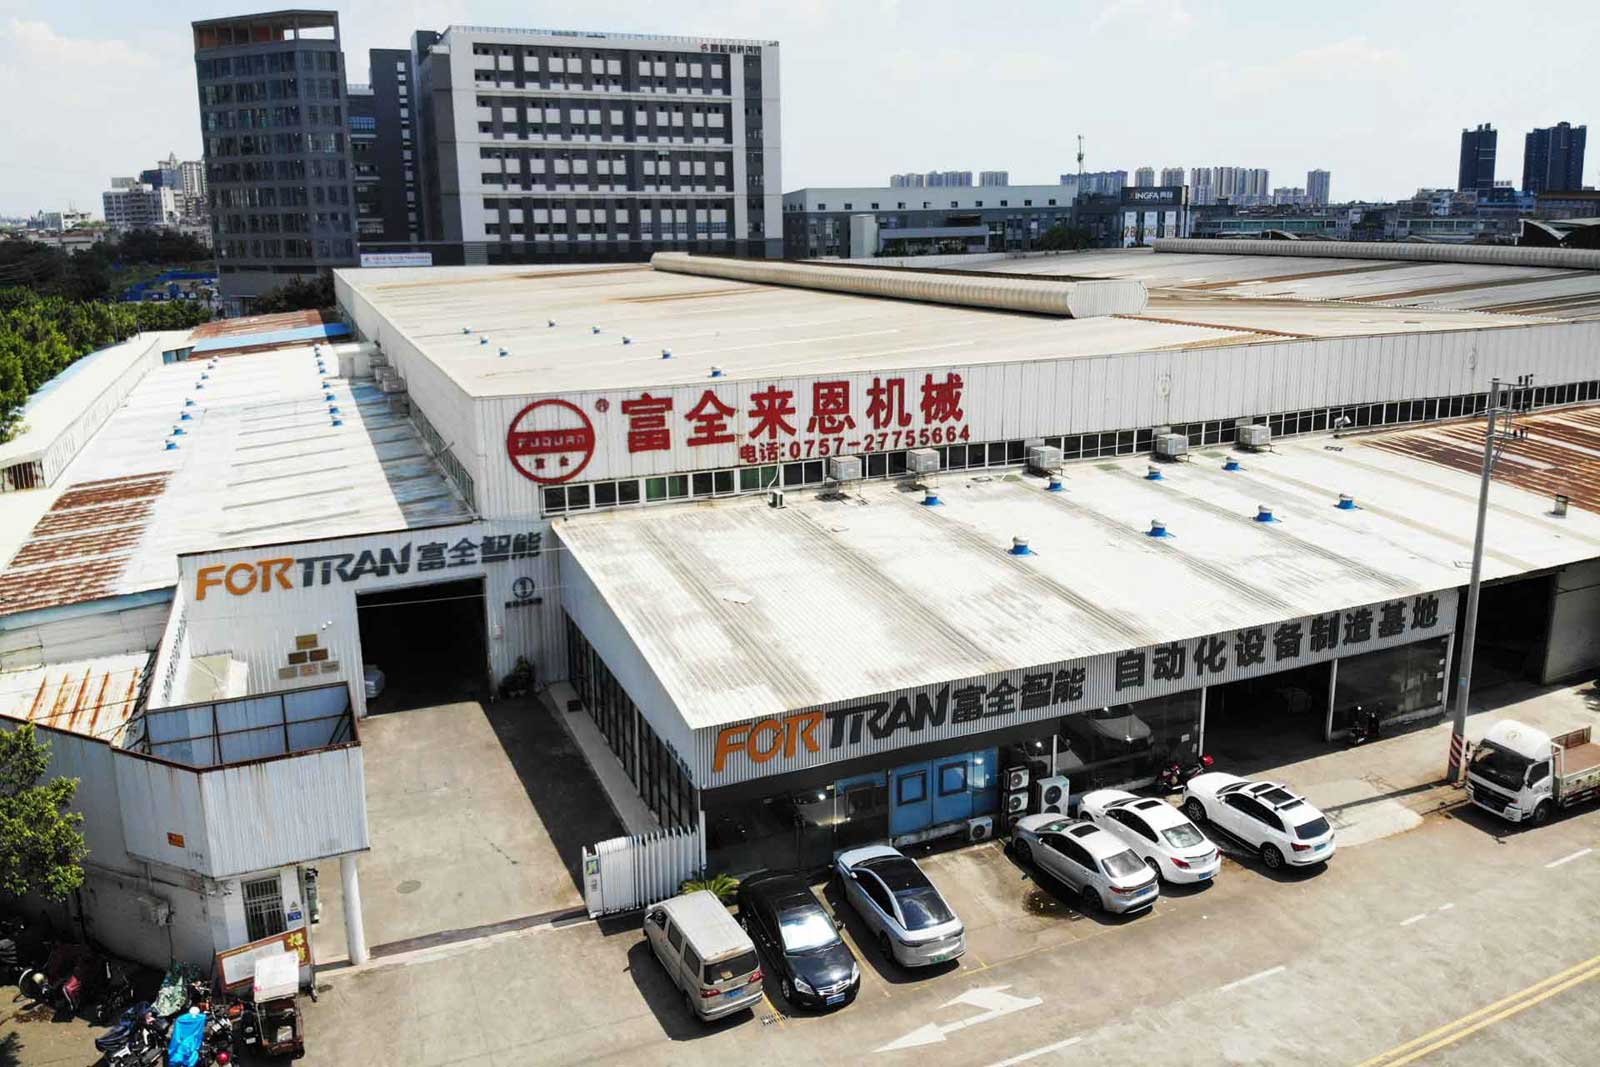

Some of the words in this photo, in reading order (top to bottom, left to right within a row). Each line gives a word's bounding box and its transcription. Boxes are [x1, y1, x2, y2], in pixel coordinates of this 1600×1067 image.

[621, 372, 964, 453] 富全来恩机械
[196, 542, 411, 600] FORTRAN
[417, 532, 543, 571] 富全智能
[713, 684, 950, 773] FORTRAN
[952, 667, 1086, 724] 富全智能
[1115, 595, 1439, 692] 自动化设备制造基地
